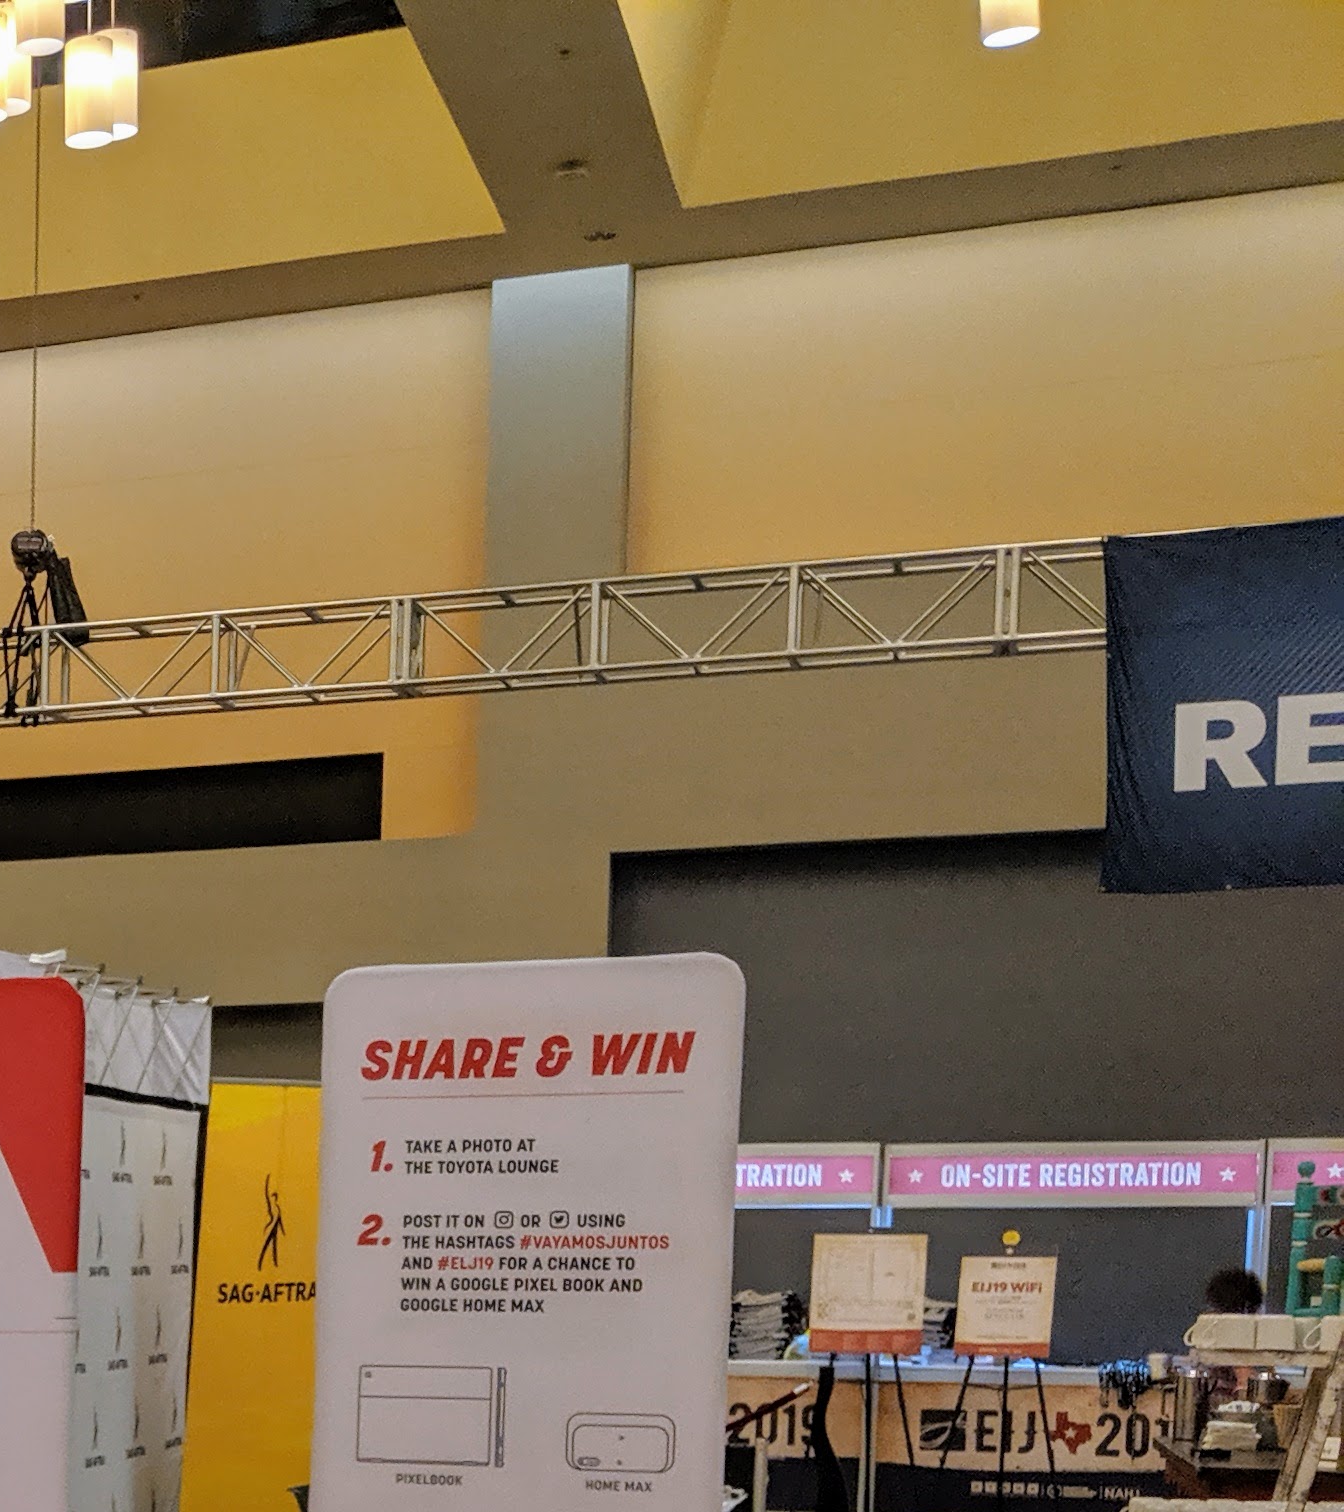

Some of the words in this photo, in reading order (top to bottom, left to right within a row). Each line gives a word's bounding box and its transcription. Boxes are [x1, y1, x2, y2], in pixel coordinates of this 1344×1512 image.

[1173, 692, 1344, 793] RE
[361, 1037, 525, 1081] SHARE
[535, 1035, 573, 1078] &
[591, 1031, 696, 1076] WIN
[370, 1140, 393, 1172] 1.
[405, 1140, 442, 1154] TAKE
[447, 1140, 457, 1153] A
[462, 1139, 512, 1153] PHOTO
[516, 1138, 536, 1152] AT
[405, 1161, 432, 1174] THE
[437, 1161, 493, 1174] TOYOTA
[498, 1160, 559, 1174] LOUNGE
[941, 1163, 1031, 1188] ON-SITE
[1039, 1161, 1202, 1187] REGISTRATION
[736, 1163, 822, 1189] TRATION
[357, 1214, 391, 1247] 2.
[403, 1214, 442, 1228] POST
[446, 1214, 459, 1228] IT
[464, 1214, 485, 1228] ON
[520, 1214, 541, 1228] OR
[577, 1214, 626, 1228] USING
[402, 1235, 430, 1249] THE
[435, 1235, 516, 1249] HASHTAGS
[520, 1235, 670, 1250] #VAYAMOSJUNTOS
[401, 1257, 433, 1270] AND
[499, 1257, 528, 1271] FOR
[532, 1257, 543, 1271] A
[547, 1257, 611, 1271] CHANCE
[616, 1257, 635, 1271] TO
[400, 1278, 431, 1292] WIN
[435, 1278, 446, 1292] A
[451, 1278, 509, 1292] GOOGLE
[514, 1278, 557, 1292] PIXEL
[562, 1278, 605, 1293] BOOK
[609, 1278, 643, 1293] AND
[400, 1299, 459, 1313] GOOGLE
[463, 1299, 506, 1313] HOME
[511, 1299, 545, 1313] MAX
[395, 1474, 463, 1487] PIXELBOOK
[585, 1480, 620, 1492] HOME
[624, 1481, 653, 1493] MAX
